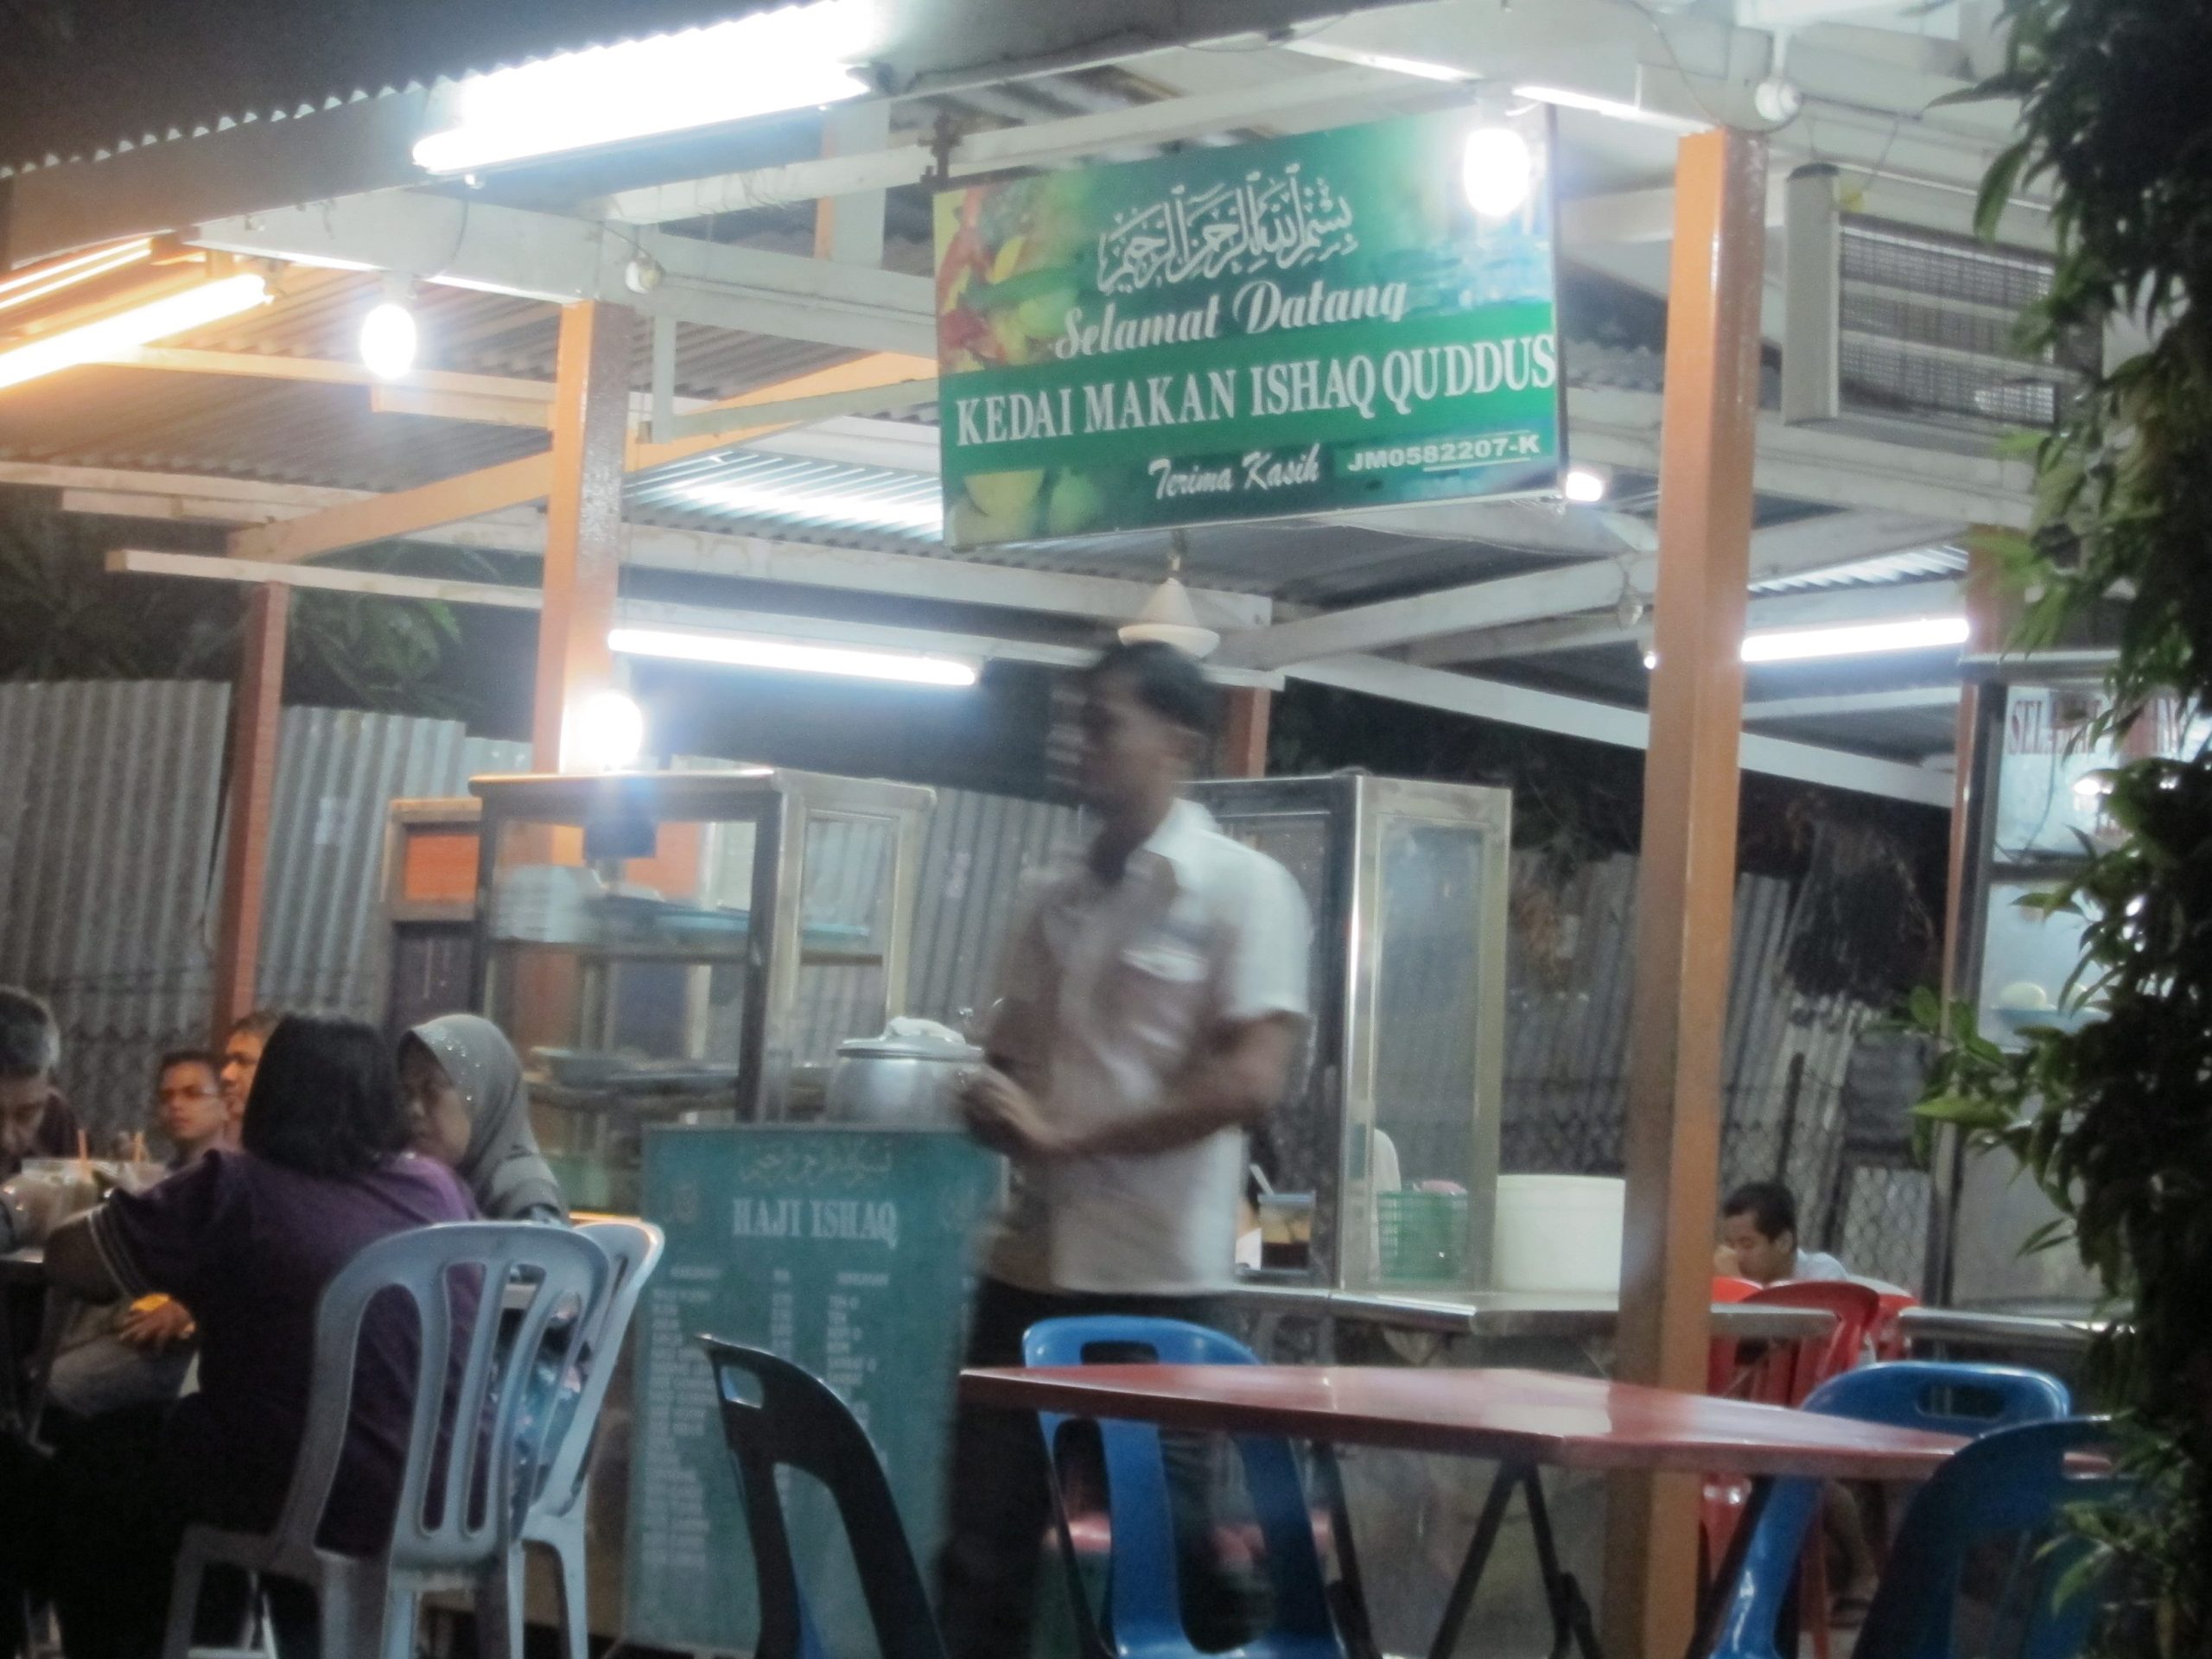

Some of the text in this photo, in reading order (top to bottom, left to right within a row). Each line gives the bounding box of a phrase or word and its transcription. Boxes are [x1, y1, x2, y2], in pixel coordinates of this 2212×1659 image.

[1053, 302, 1221, 359] Selamat
[956, 334, 1555, 446] KEDAI MAKAN ISHAQ QUDDUS
[1148, 443, 1320, 500] Terima Kasih
[1347, 435, 1541, 474] JM0582207-K
[733, 1198, 899, 1250] HAJI ISHAQ
